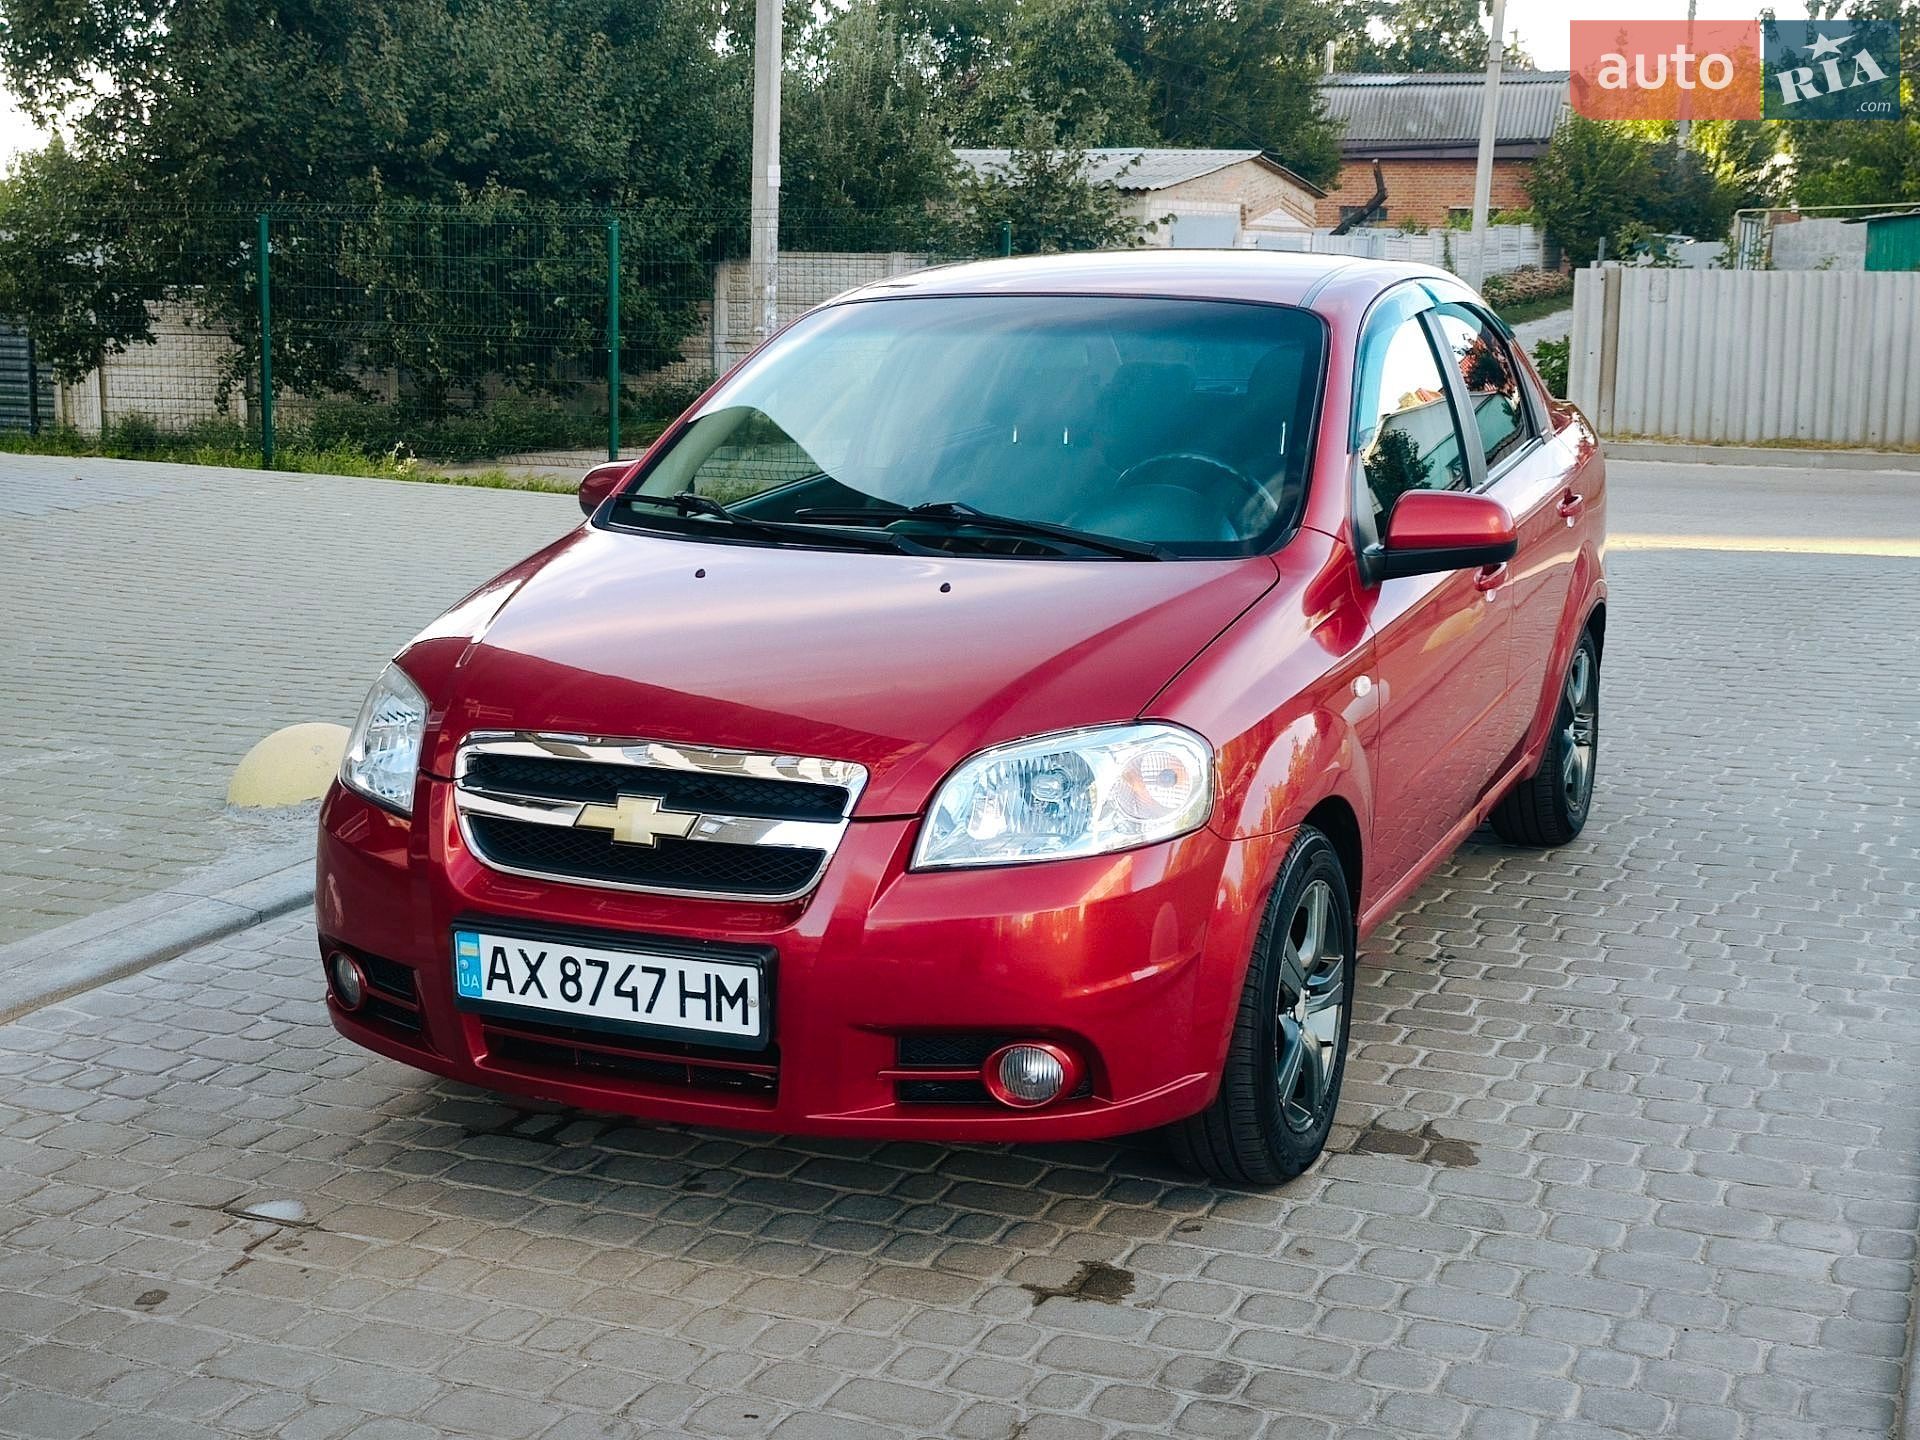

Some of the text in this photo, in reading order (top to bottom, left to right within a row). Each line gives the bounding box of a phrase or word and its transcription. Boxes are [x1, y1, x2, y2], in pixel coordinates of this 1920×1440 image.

[461, 972, 480, 989] UA
[486, 946, 750, 1026] AX 8747 HM
